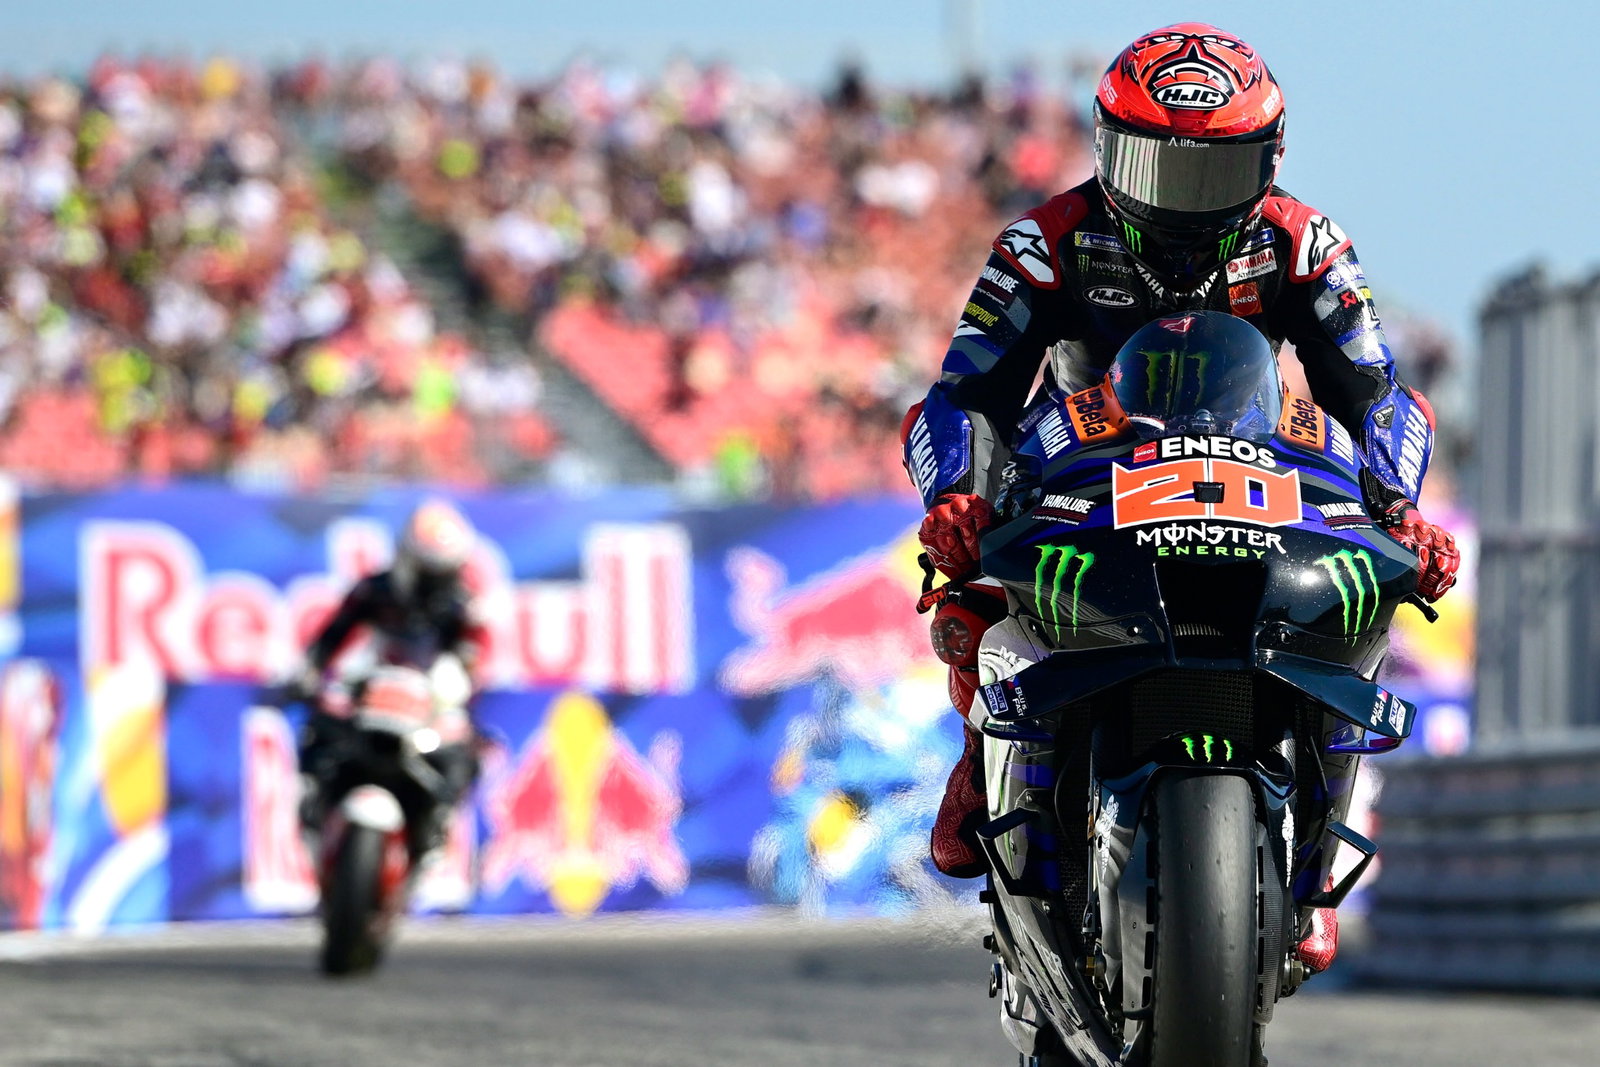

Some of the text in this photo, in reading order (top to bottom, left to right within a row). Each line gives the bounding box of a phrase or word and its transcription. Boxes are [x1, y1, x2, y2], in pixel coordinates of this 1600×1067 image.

[1161, 88, 1219, 104] HJC
[1239, 250, 1274, 270] YAMAHA
[1091, 289, 1133, 304] HJC
[1231, 295, 1258, 305] ENEOS
[1076, 399, 1110, 437] Beta
[1290, 398, 1318, 432] Beta
[1036, 407, 1072, 459] YAMAHA
[1398, 404, 1428, 494] YAMAHA
[909, 411, 939, 496] YAMAHA
[1161, 436, 1276, 468] ENEOS
[1041, 494, 1095, 514] YAMALUBE
[1112, 457, 1303, 530] 20
[1316, 502, 1366, 518] YAMALUBE
[1136, 522, 1286, 554] MONSTER
[1157, 545, 1265, 559] ENERGY
